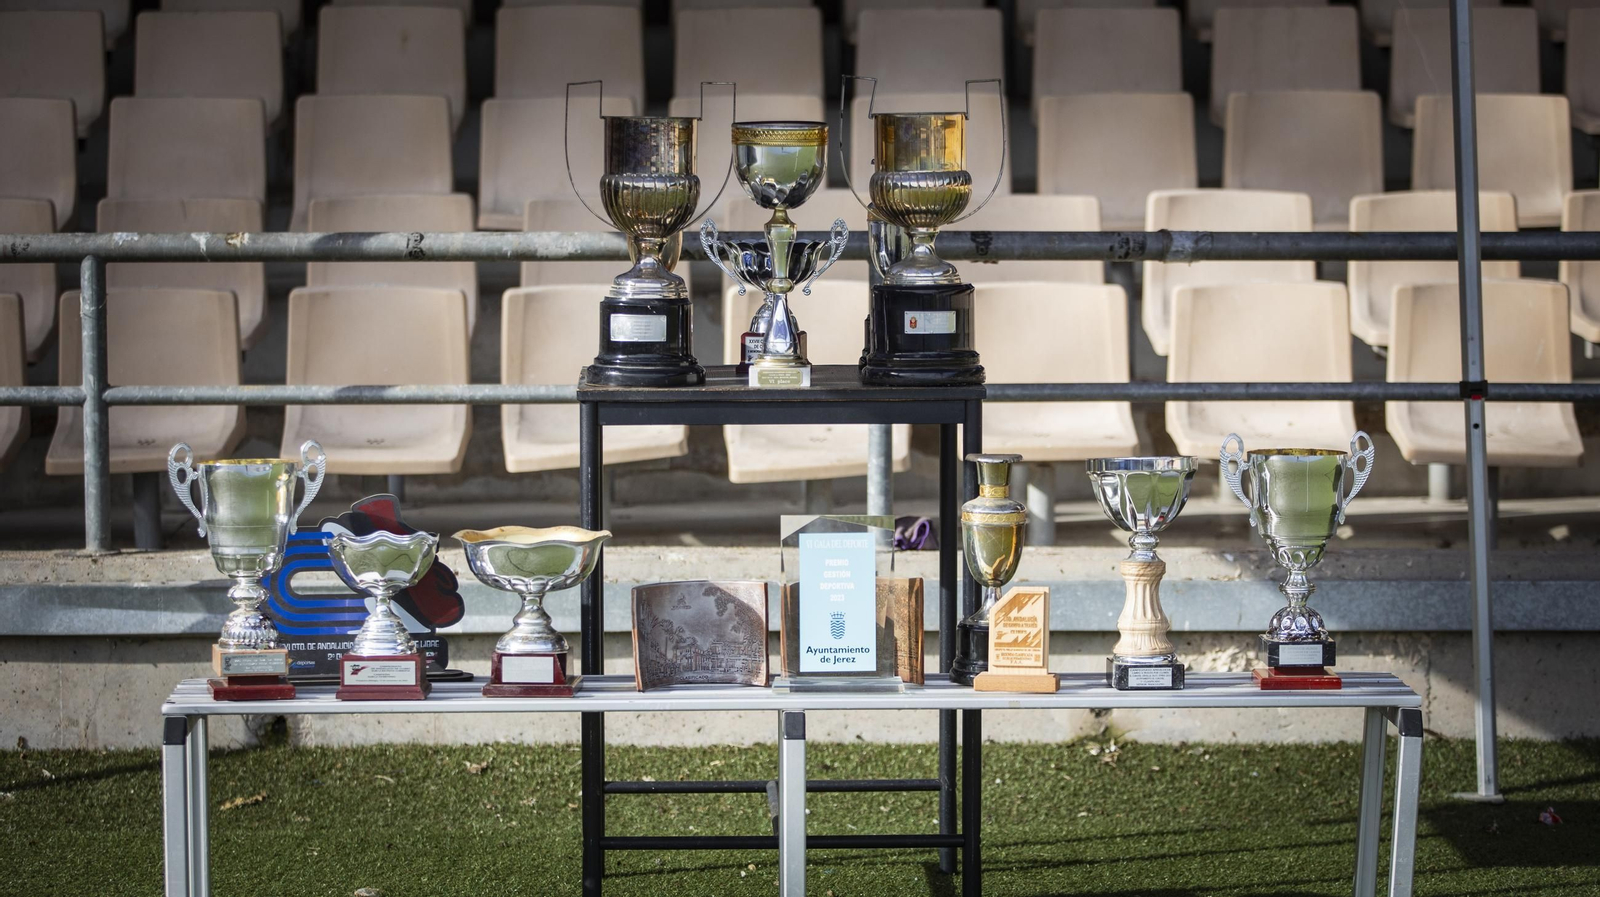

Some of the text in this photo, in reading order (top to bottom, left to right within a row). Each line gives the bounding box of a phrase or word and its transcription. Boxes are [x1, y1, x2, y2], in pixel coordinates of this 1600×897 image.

[814, 539, 830, 549] GALA
[831, 539, 842, 549] DEL
[842, 539, 869, 549] DEPORTE
[825, 559, 849, 567] PREMIO
[819, 582, 855, 590] DEPORTIVA
[317, 641, 354, 650] ANDALUCÍA
[420, 640, 440, 648] LIBRE
[806, 646, 870, 656] Ayuntamiento
[820, 655, 856, 665] de Jerez
